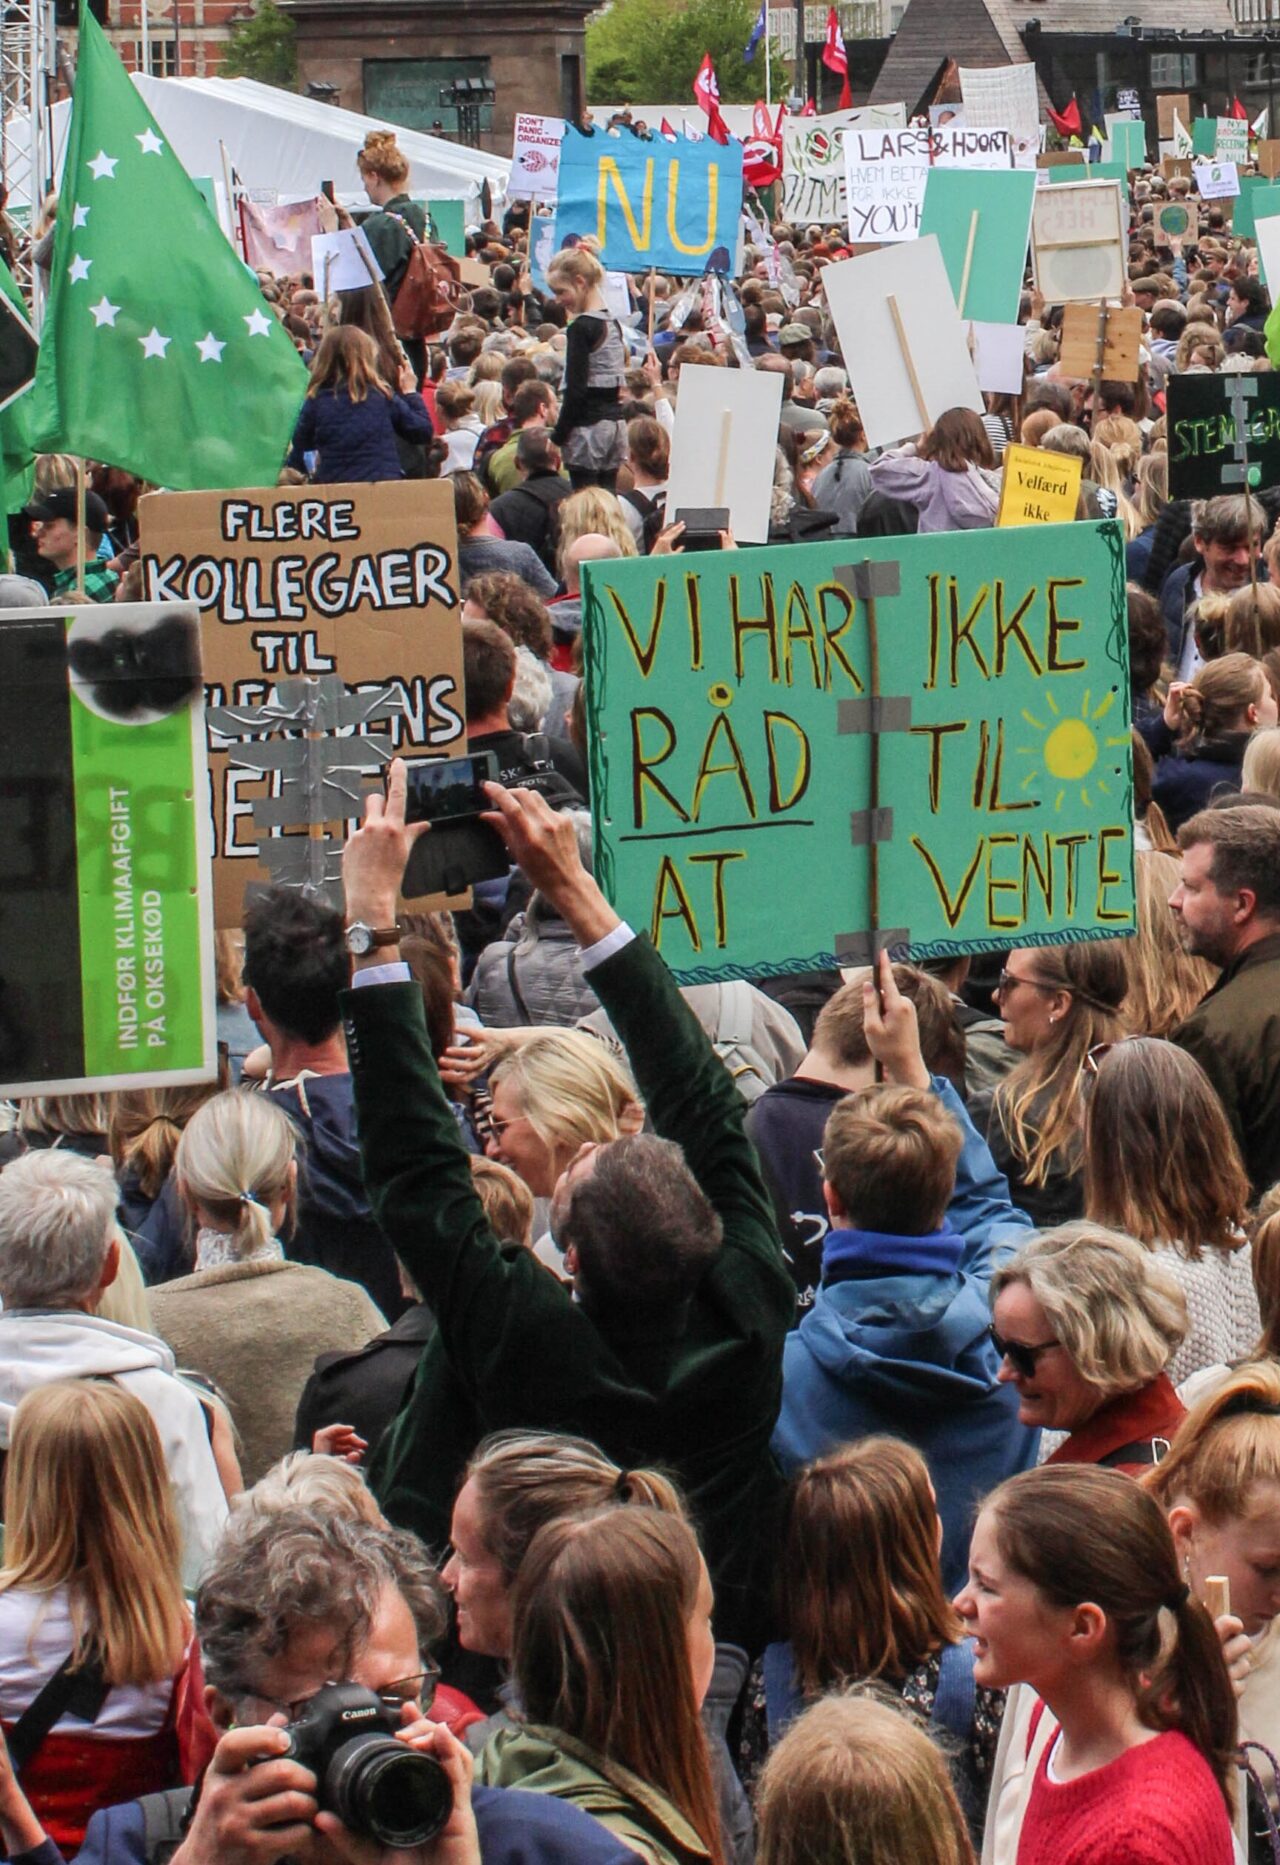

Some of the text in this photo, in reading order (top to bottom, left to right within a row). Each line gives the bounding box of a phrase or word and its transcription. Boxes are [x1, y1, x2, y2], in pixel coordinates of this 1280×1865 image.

[517, 125, 543, 136] PANIC
[518, 116, 544, 127] DON'T
[858, 130, 929, 161] LARS
[952, 130, 1009, 157] HJORT
[850, 167, 885, 185] HVEM
[850, 186, 918, 201] FOR IKKE
[597, 154, 719, 257] NU
[1017, 471, 1067, 496] Velfærd
[222, 499, 361, 541] FLERE
[1023, 502, 1050, 522] ikke
[142, 543, 460, 625] KOLLEGAER
[251, 631, 336, 674] TIL
[602, 571, 1088, 694] VI HAR IKKE
[628, 681, 1041, 830] RÅD TIL
[648, 827, 1132, 953] AT VENTE
[108, 785, 139, 1050] INDFØR KLIMAAFGIFT
[141, 889, 167, 1047] PÅ OKSEKØD
[341, 1707, 377, 1721] Canon
